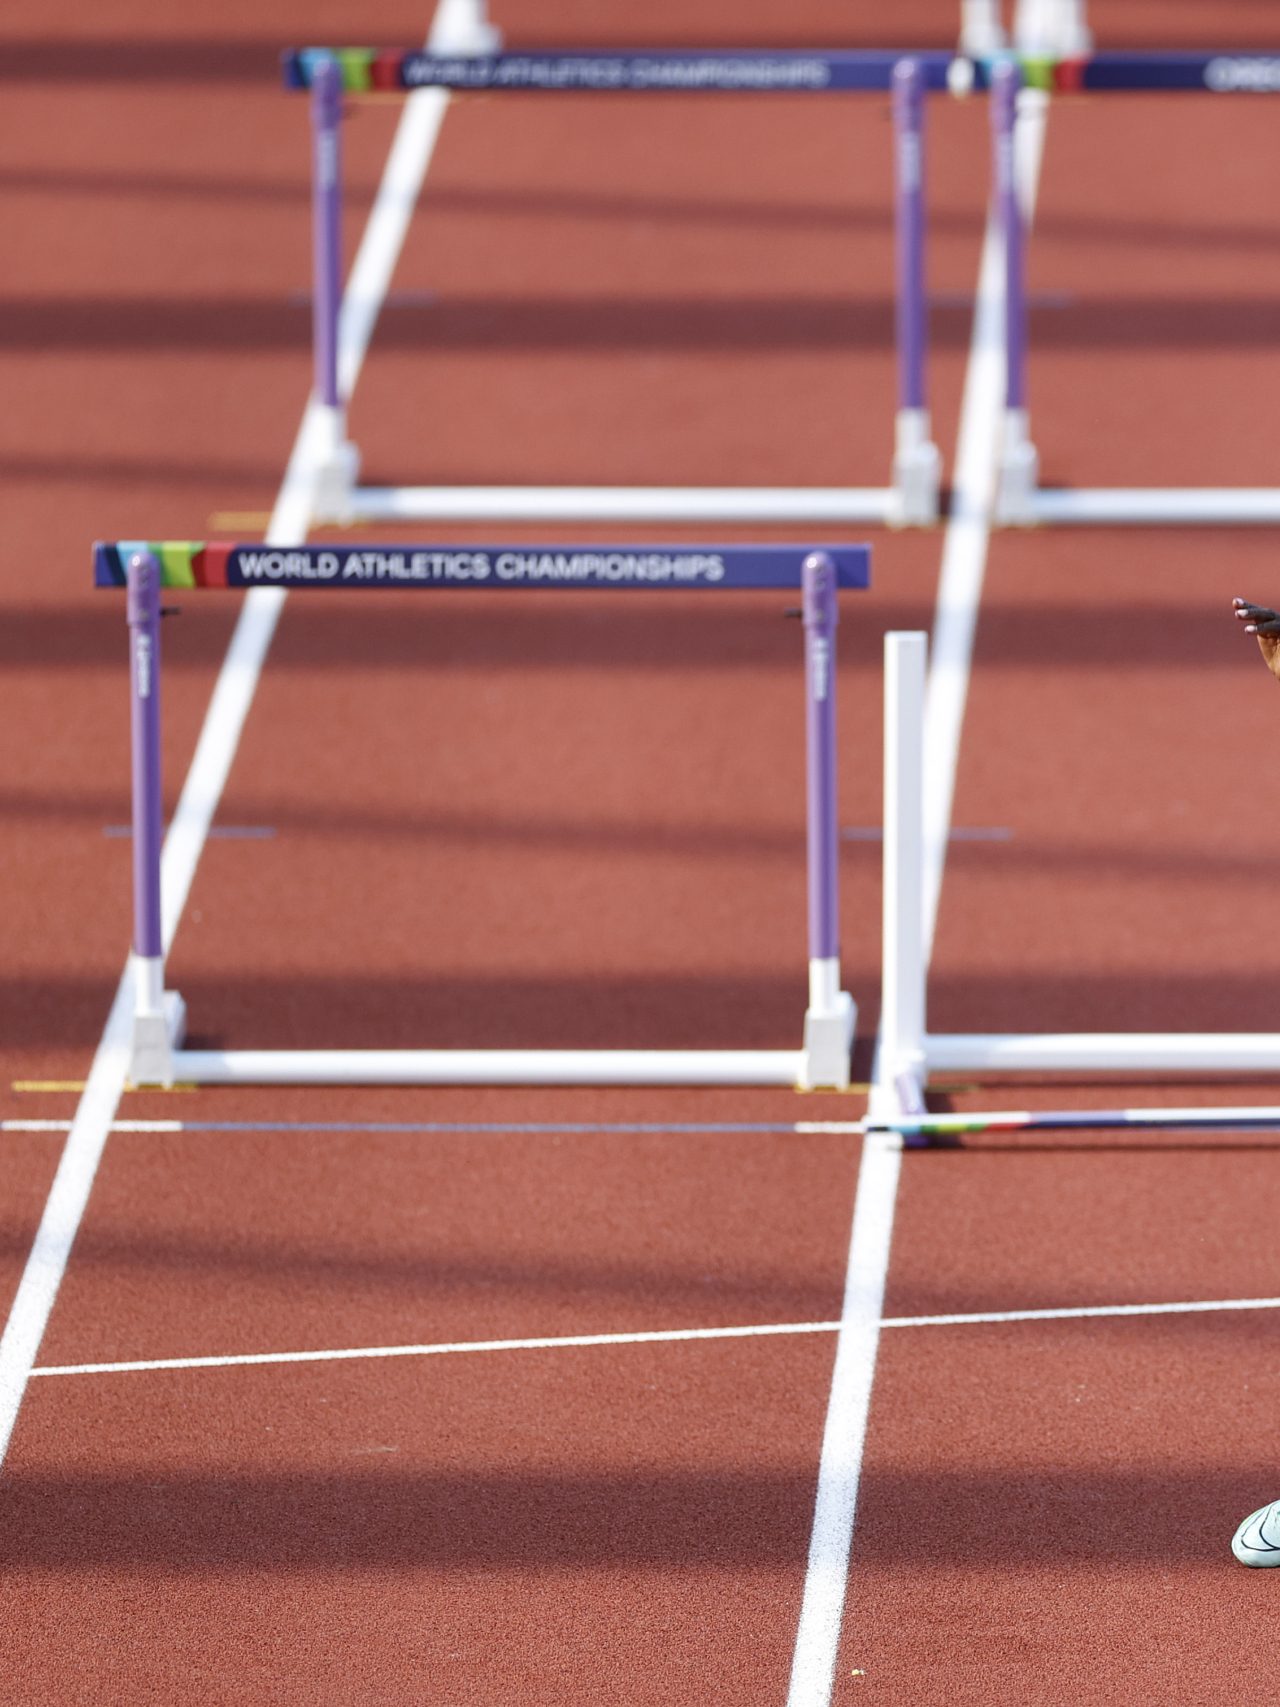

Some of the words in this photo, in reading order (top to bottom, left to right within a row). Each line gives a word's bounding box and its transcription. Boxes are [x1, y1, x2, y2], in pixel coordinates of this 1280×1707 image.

[238, 553, 339, 579] WORLD
[342, 553, 491, 579] ATHLETICS
[495, 553, 725, 581] CHAMPIONSHIPS
